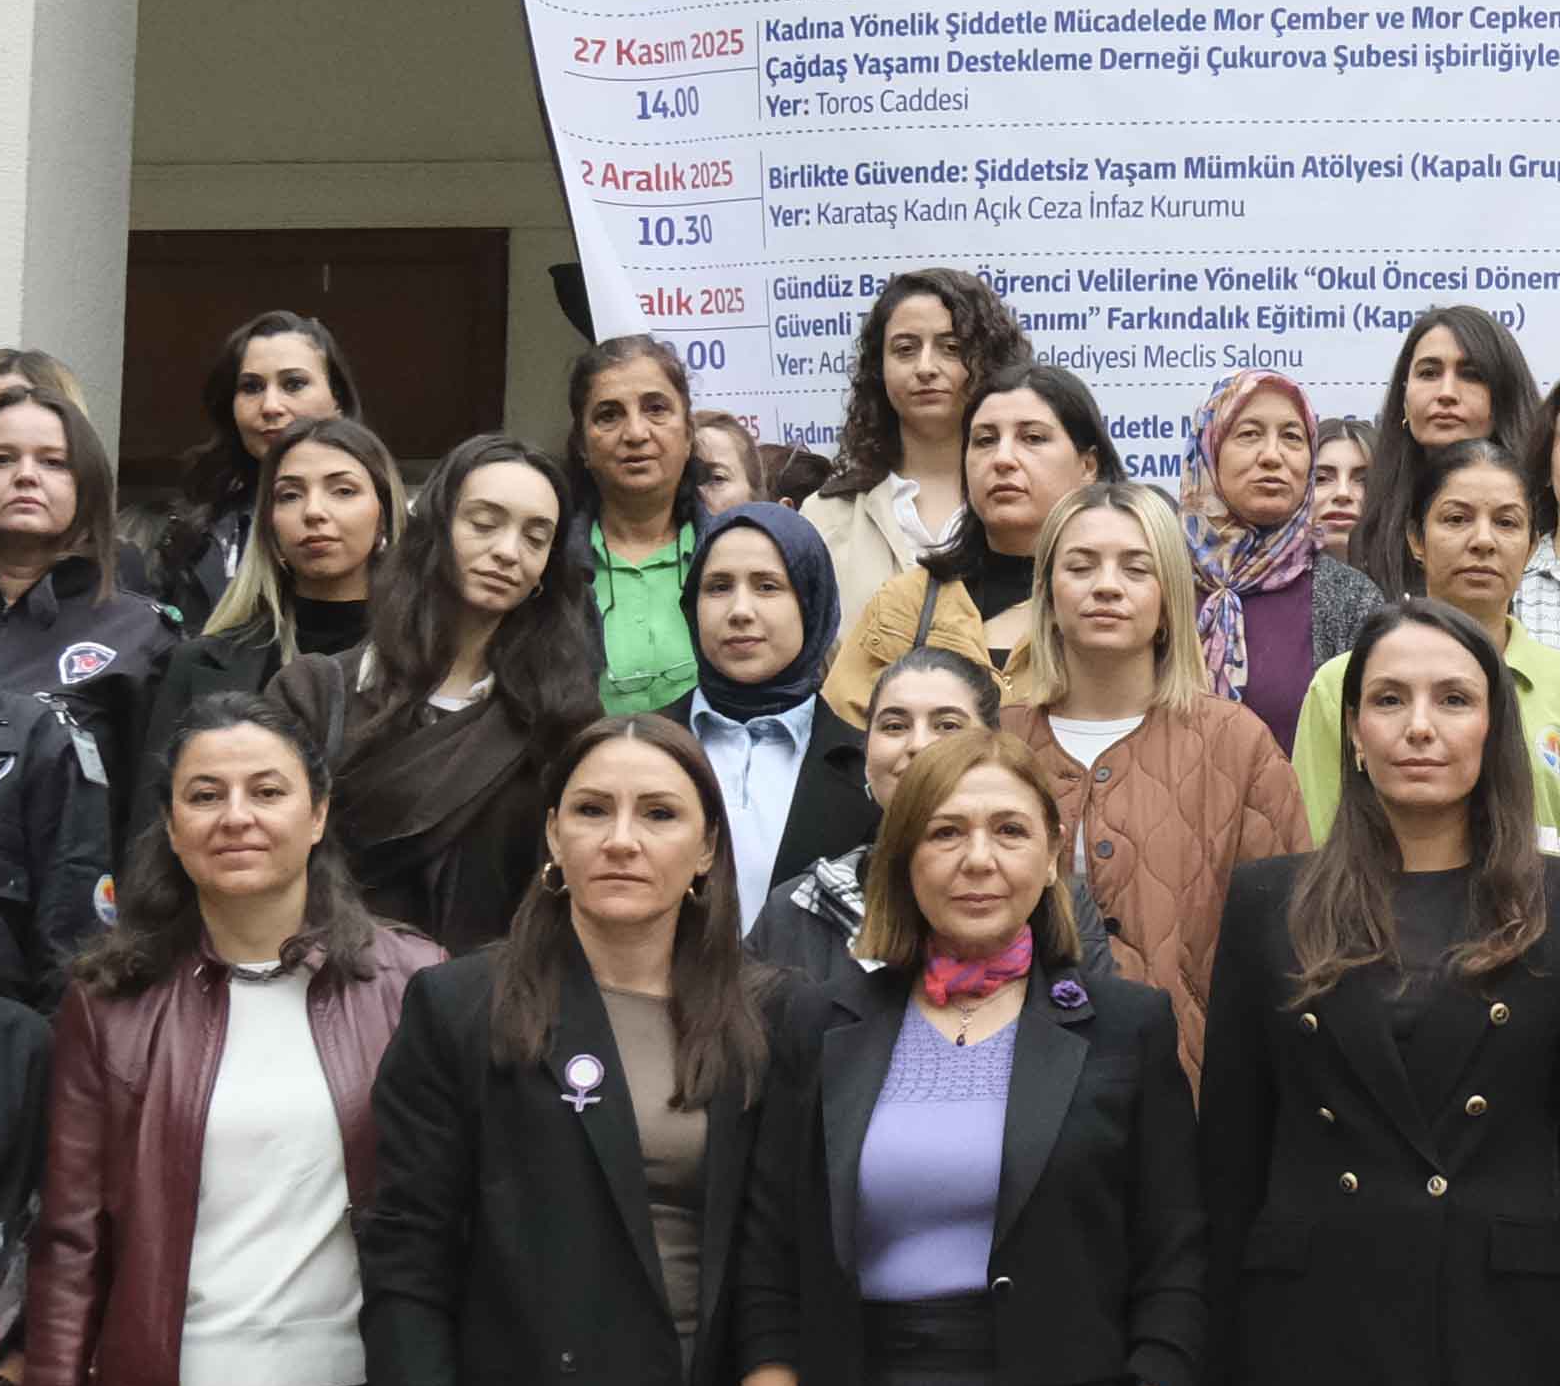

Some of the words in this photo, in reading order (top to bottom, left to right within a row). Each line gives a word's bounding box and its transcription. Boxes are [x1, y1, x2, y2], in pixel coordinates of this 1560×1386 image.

[573, 36, 607, 65] 27
[616, 38, 688, 66] Kasım
[689, 28, 745, 60] 2025
[636, 85, 700, 121] 14.00
[600, 161, 687, 193] Aralık
[689, 159, 734, 190] 2025
[768, 204, 811, 228] Yer:
[817, 201, 898, 230] Karataş
[903, 196, 968, 222] Kadın
[973, 195, 1022, 228] Açık
[1027, 196, 1083, 220] Ceza
[1089, 193, 1145, 219] İnfaz
[1151, 194, 1245, 218] Kurumu
[637, 213, 713, 247] 10.30
[1076, 267, 1199, 293] Velilerine
[1204, 266, 1299, 292] Yönelik
[1382, 260, 1468, 291] Öncesi
[700, 287, 744, 315] 2025
